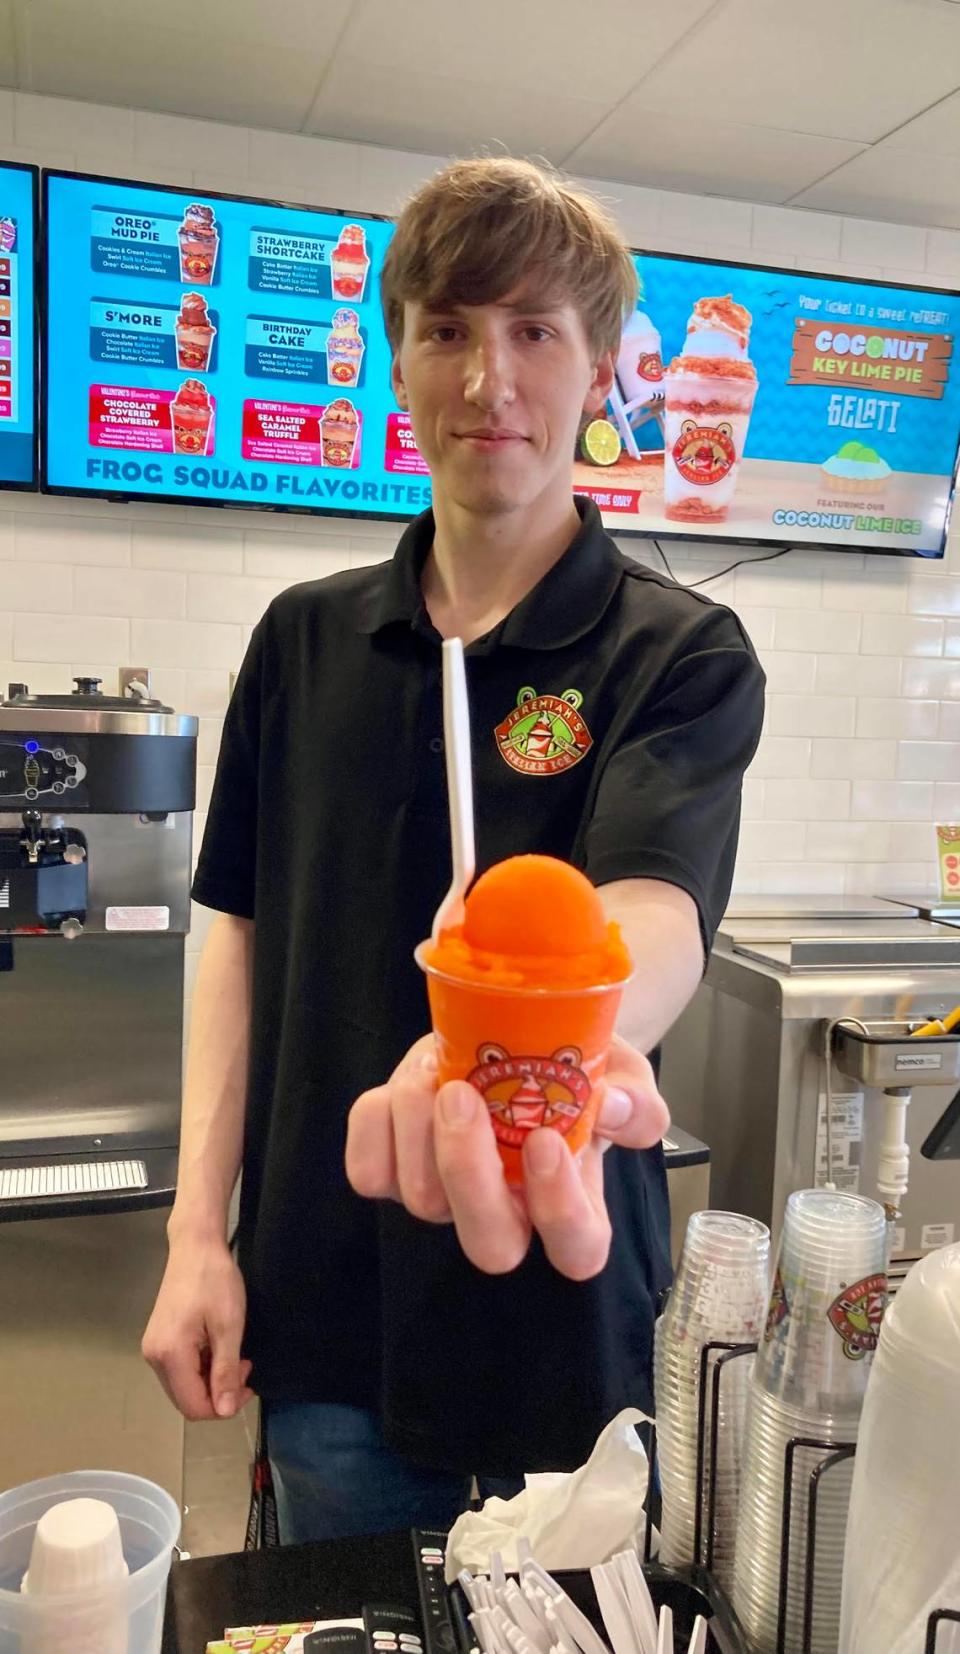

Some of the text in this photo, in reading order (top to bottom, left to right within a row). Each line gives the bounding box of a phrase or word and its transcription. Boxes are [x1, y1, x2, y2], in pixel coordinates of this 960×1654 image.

[111, 228, 160, 241] MUD PIE
[257, 236, 325, 251] STRAWBERRY
[98, 245, 120, 254] Cookies
[126, 248, 144, 256] Cream
[257, 245, 325, 261] SHORTCAKE
[120, 262, 139, 271] Cookie
[140, 264, 166, 274] Crumbles
[263, 268, 291, 277] Strawberry
[295, 285, 320, 294] Crumbles
[105, 311, 162, 327] S'MORE
[101, 331, 120, 339] Cookie
[263, 324, 312, 335] BIRTHDAY
[106, 339, 133, 347] Chocolate
[268, 334, 304, 347] CAKE
[815, 330, 928, 362] COCONUT
[138, 356, 164, 364] Crumbles
[812, 357, 923, 383] KEY LIME PIE
[104, 399, 157, 411] CHOCOLATE
[109, 408, 151, 418] COVERED
[827, 394, 900, 433] GELATI
[100, 415, 160, 427] STRAWBERRY
[275, 415, 306, 425] SALTED
[261, 422, 301, 432] CARAMEL
[263, 430, 299, 439] TRUFFLE
[86, 459, 432, 505] FROG SQUAD FLAVORITES
[817, 499, 885, 511] FEATURING OUR
[772, 509, 922, 535] COCONUT LIME ICE
[508, 700, 583, 731] JEREMIAH'S
